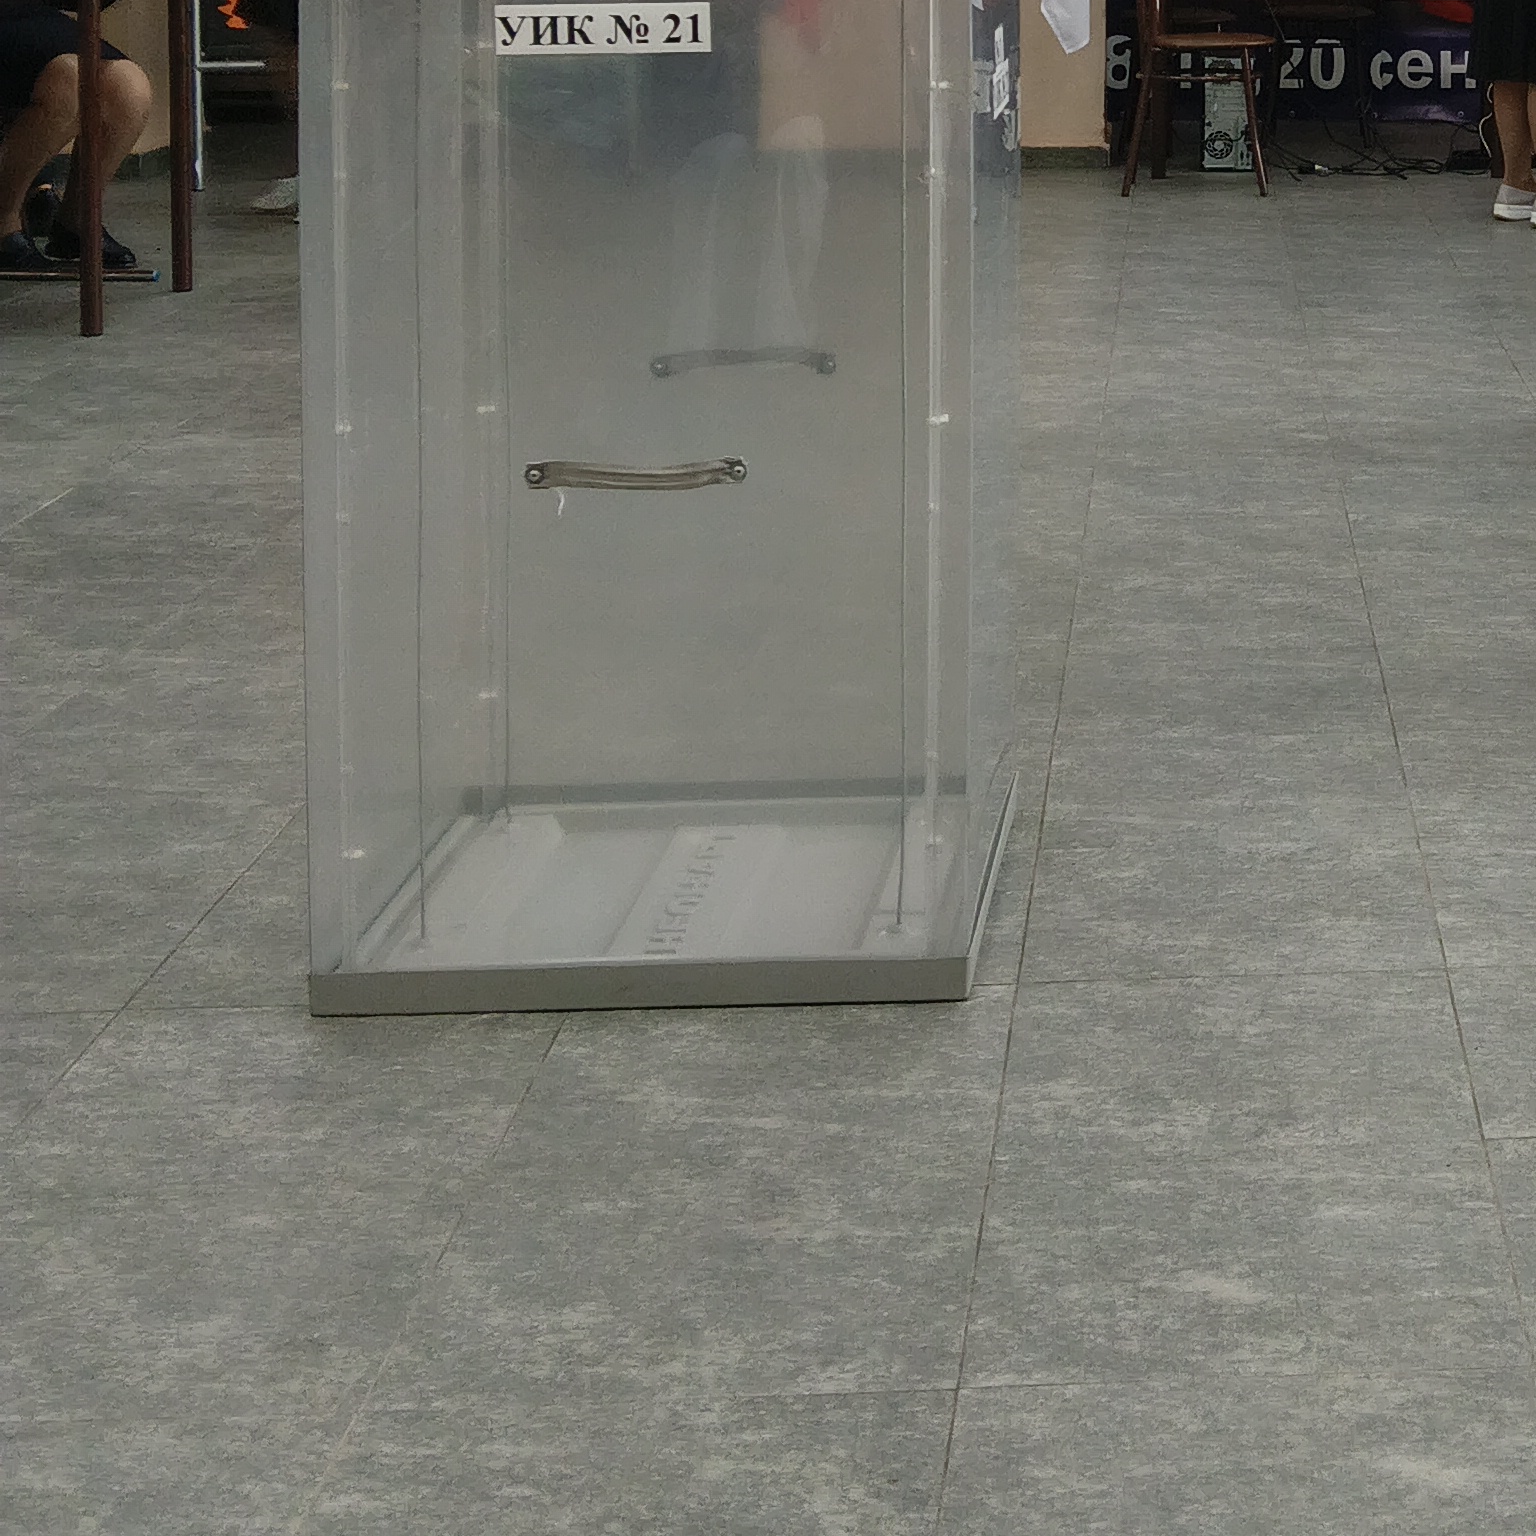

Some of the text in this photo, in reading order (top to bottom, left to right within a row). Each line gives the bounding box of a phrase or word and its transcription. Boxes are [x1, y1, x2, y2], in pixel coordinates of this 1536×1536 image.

[496, 13, 704, 46] УИК № 21
